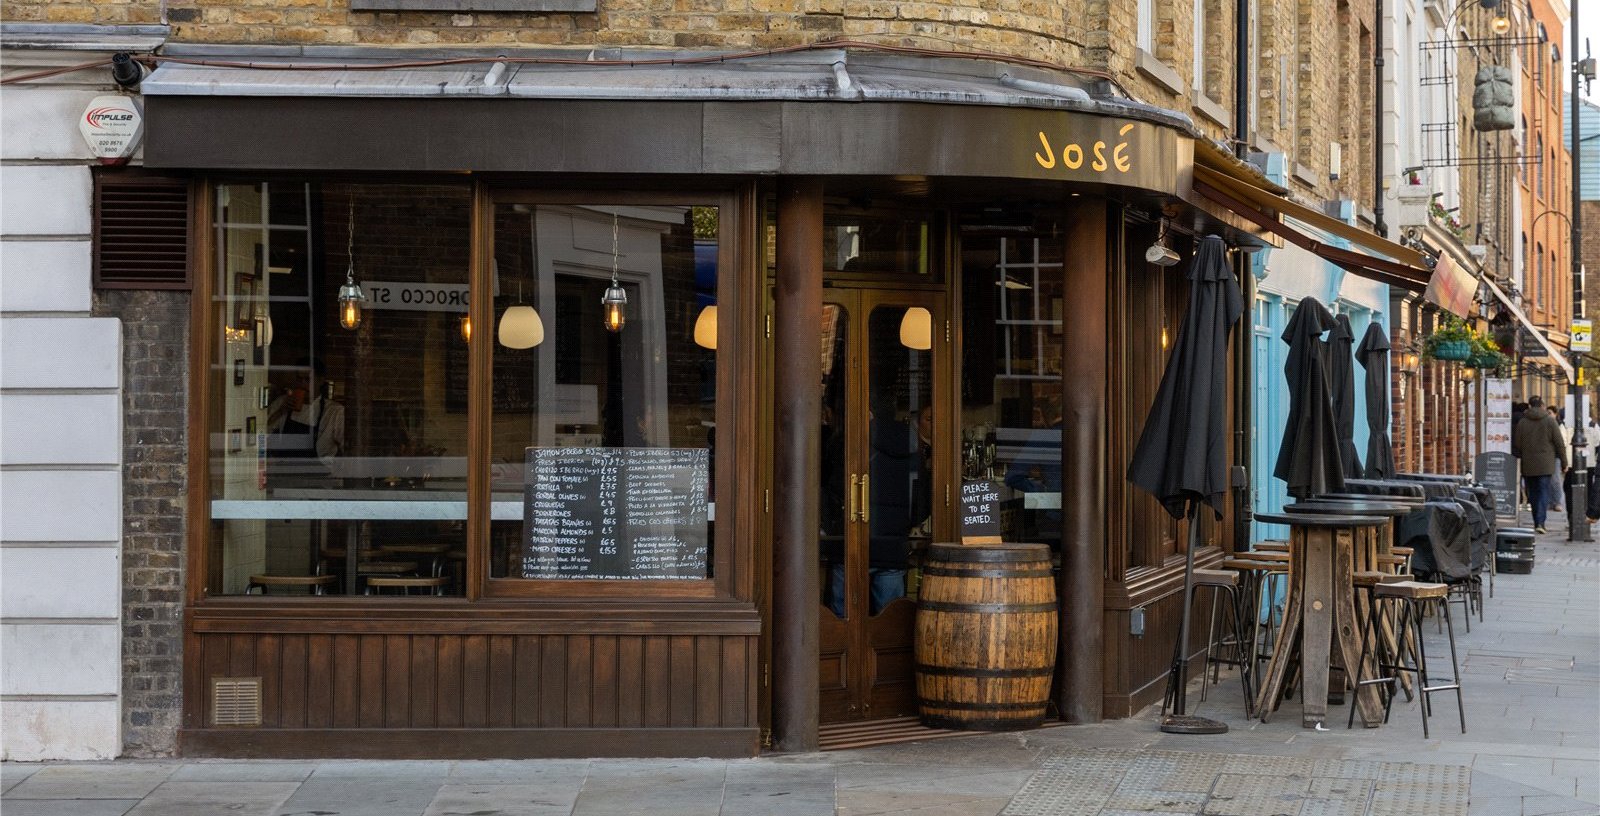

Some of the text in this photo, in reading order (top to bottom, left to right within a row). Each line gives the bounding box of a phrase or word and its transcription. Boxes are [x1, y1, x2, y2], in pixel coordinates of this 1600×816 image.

[1036, 124, 1134, 172] JOSÉ
[536, 484, 560, 492] TORTILLA
[963, 482, 990, 494] PLEASE
[982, 492, 999, 502] HERE
[980, 504, 990, 513] BE
